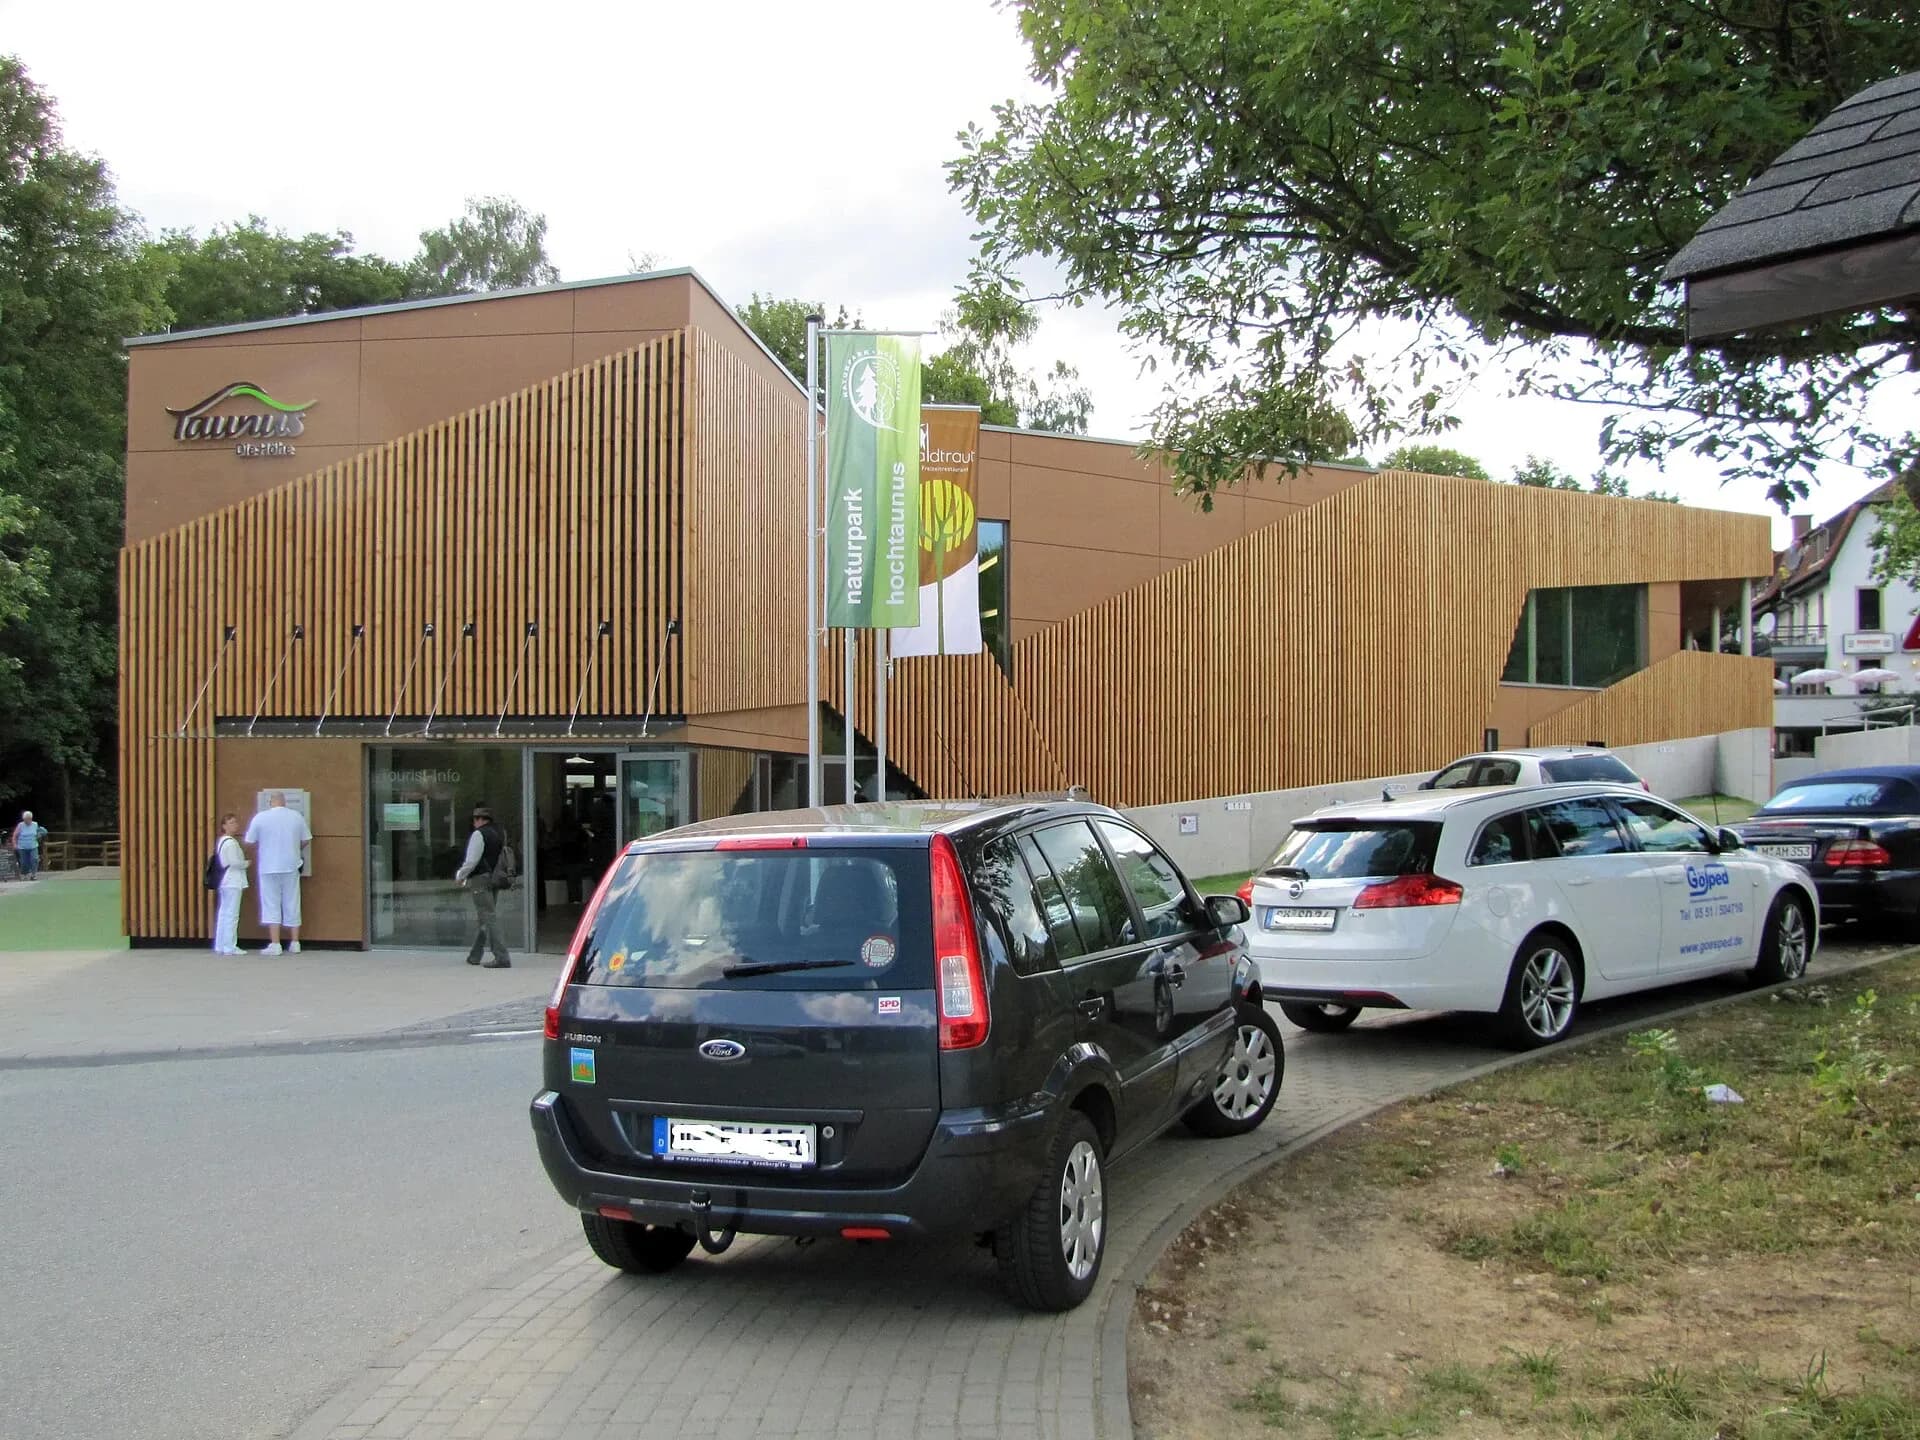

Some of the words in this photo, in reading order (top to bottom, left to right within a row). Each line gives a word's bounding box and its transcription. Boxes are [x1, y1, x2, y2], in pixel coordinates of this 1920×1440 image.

[165, 406, 308, 441] Taunus
[920, 447, 976, 464] aldtraut
[885, 461, 906, 606] hochtaunus
[842, 487, 867, 605] naturpark
[879, 1000, 900, 1008] SPD
[563, 1032, 602, 1043] FUSION
[708, 1043, 733, 1056] Ford
[657, 1138, 665, 1147] D
